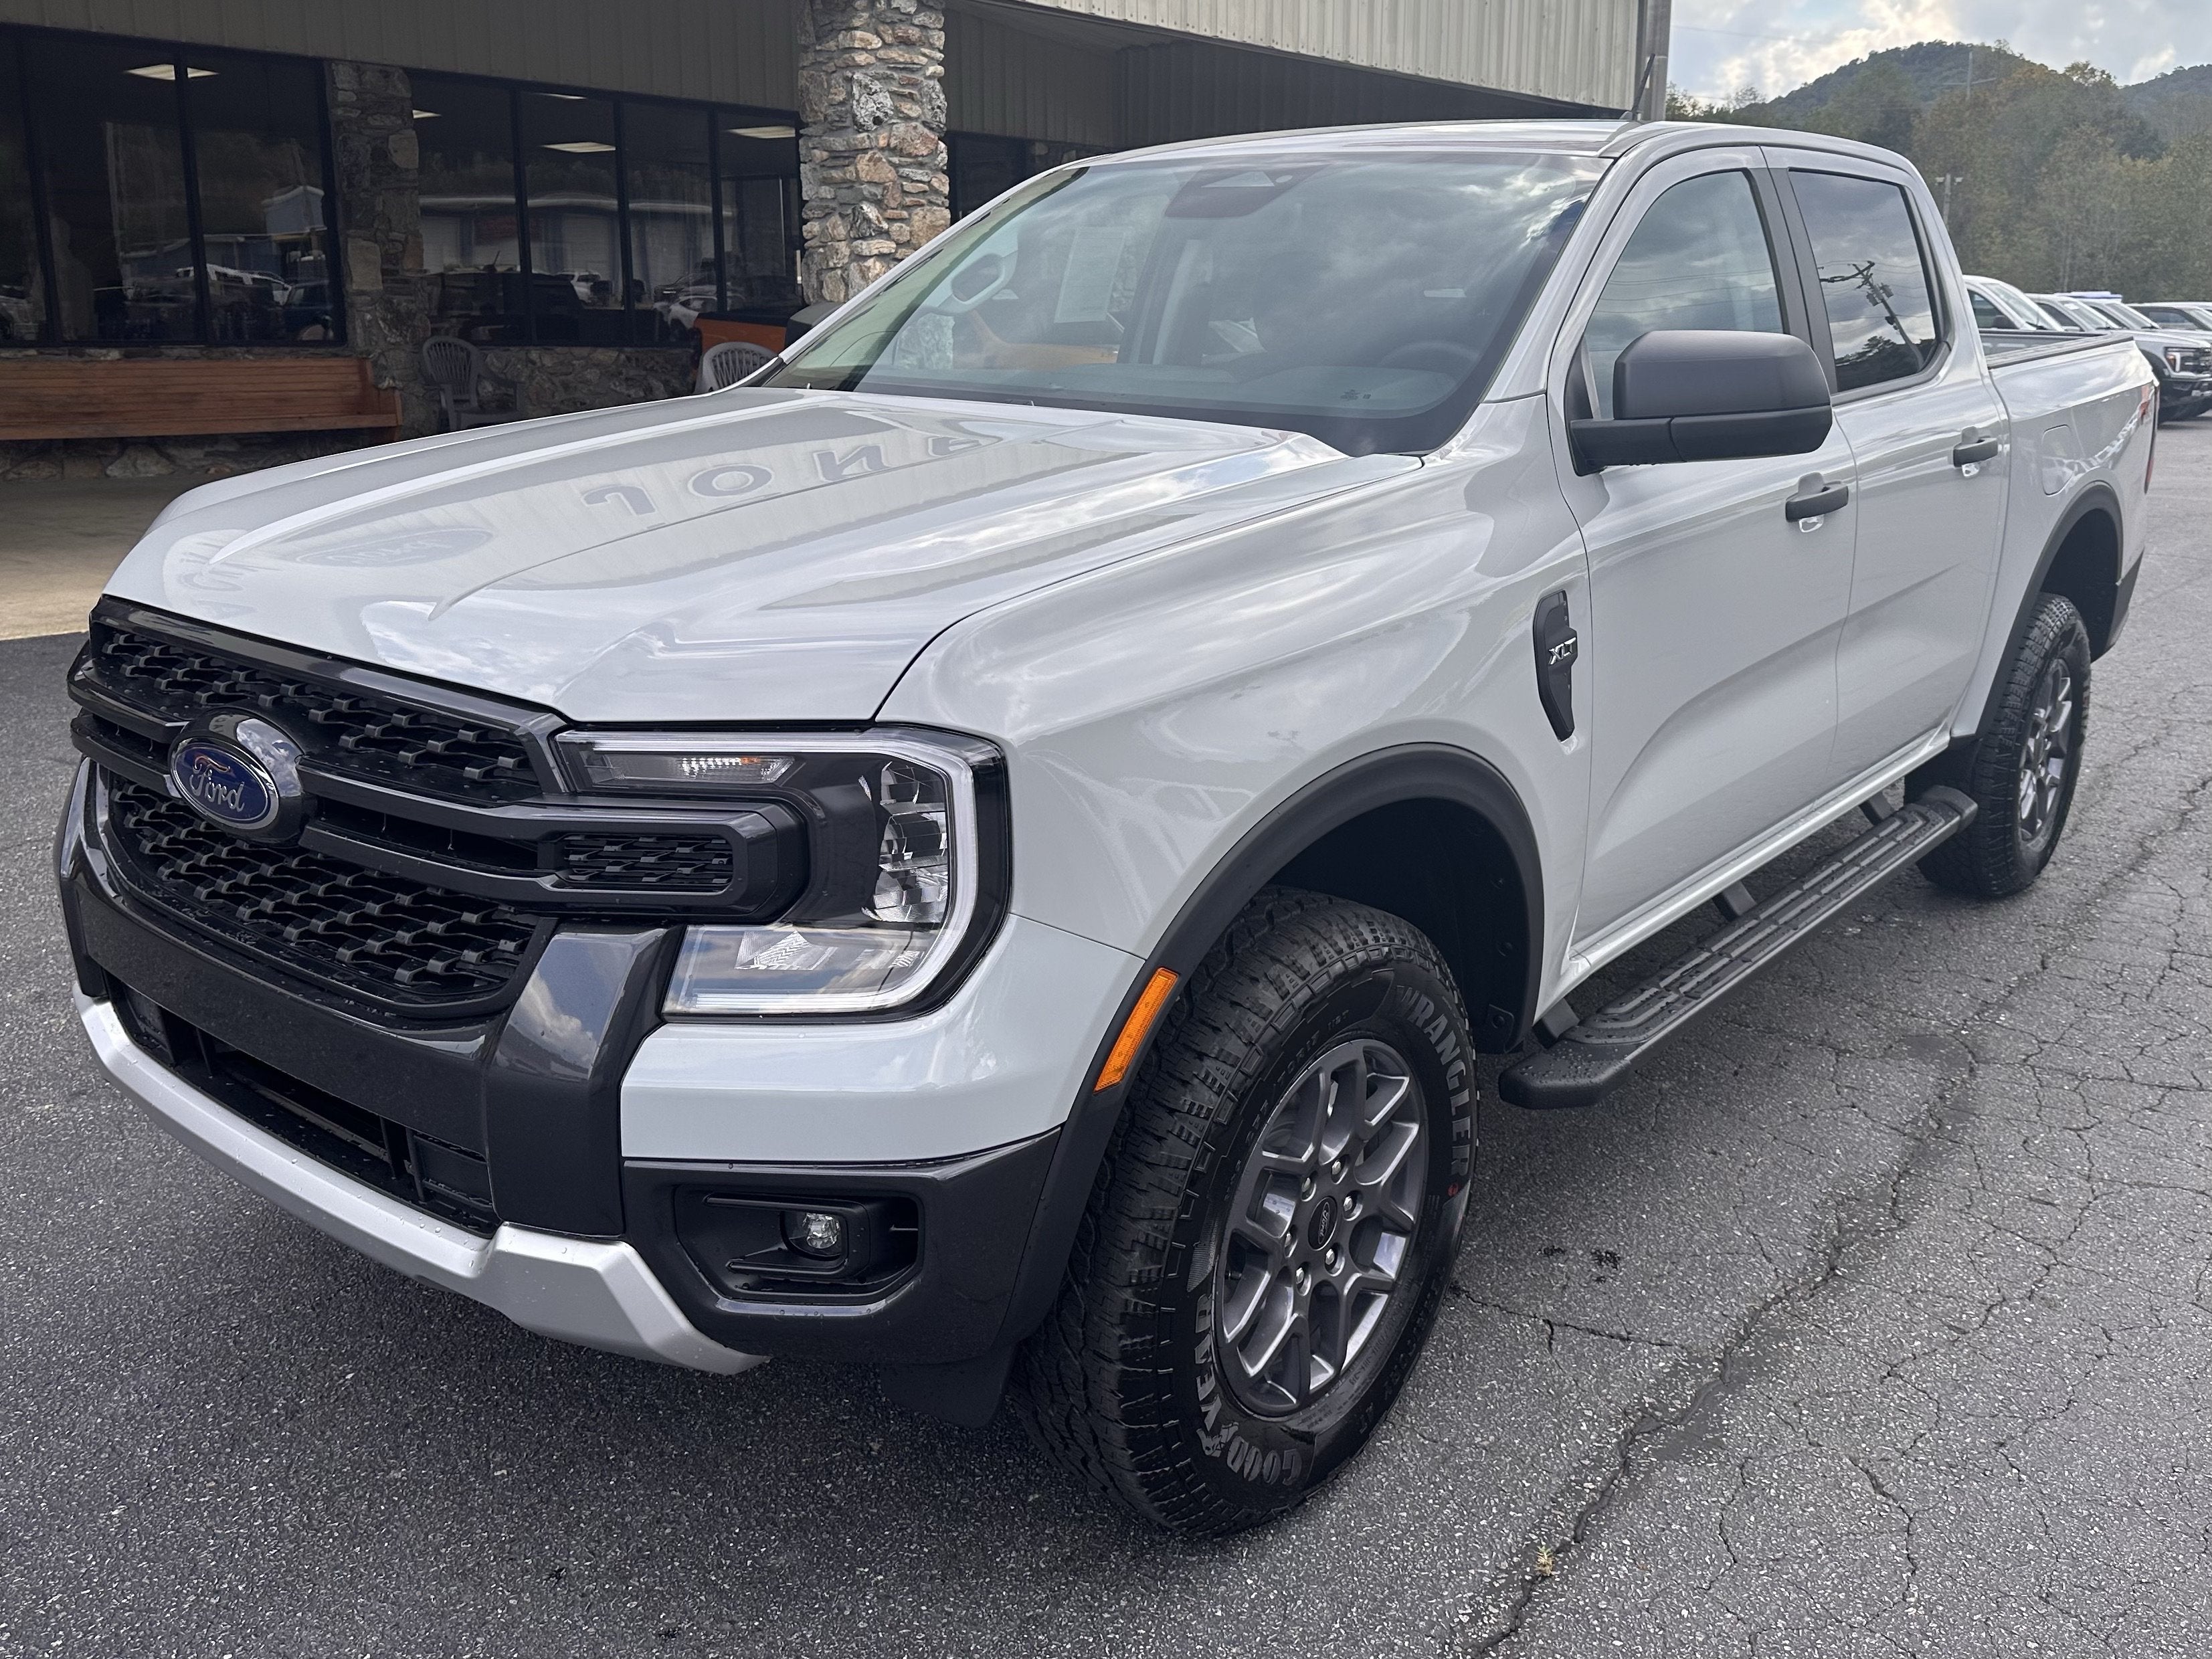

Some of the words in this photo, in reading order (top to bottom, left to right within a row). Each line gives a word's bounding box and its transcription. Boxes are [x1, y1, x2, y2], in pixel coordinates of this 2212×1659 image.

[1548, 637, 1577, 665] XLT
[189, 755, 246, 812] Ford
[1396, 985, 1471, 1177] WRANGLER
[1319, 1209, 1329, 1237] Ford
